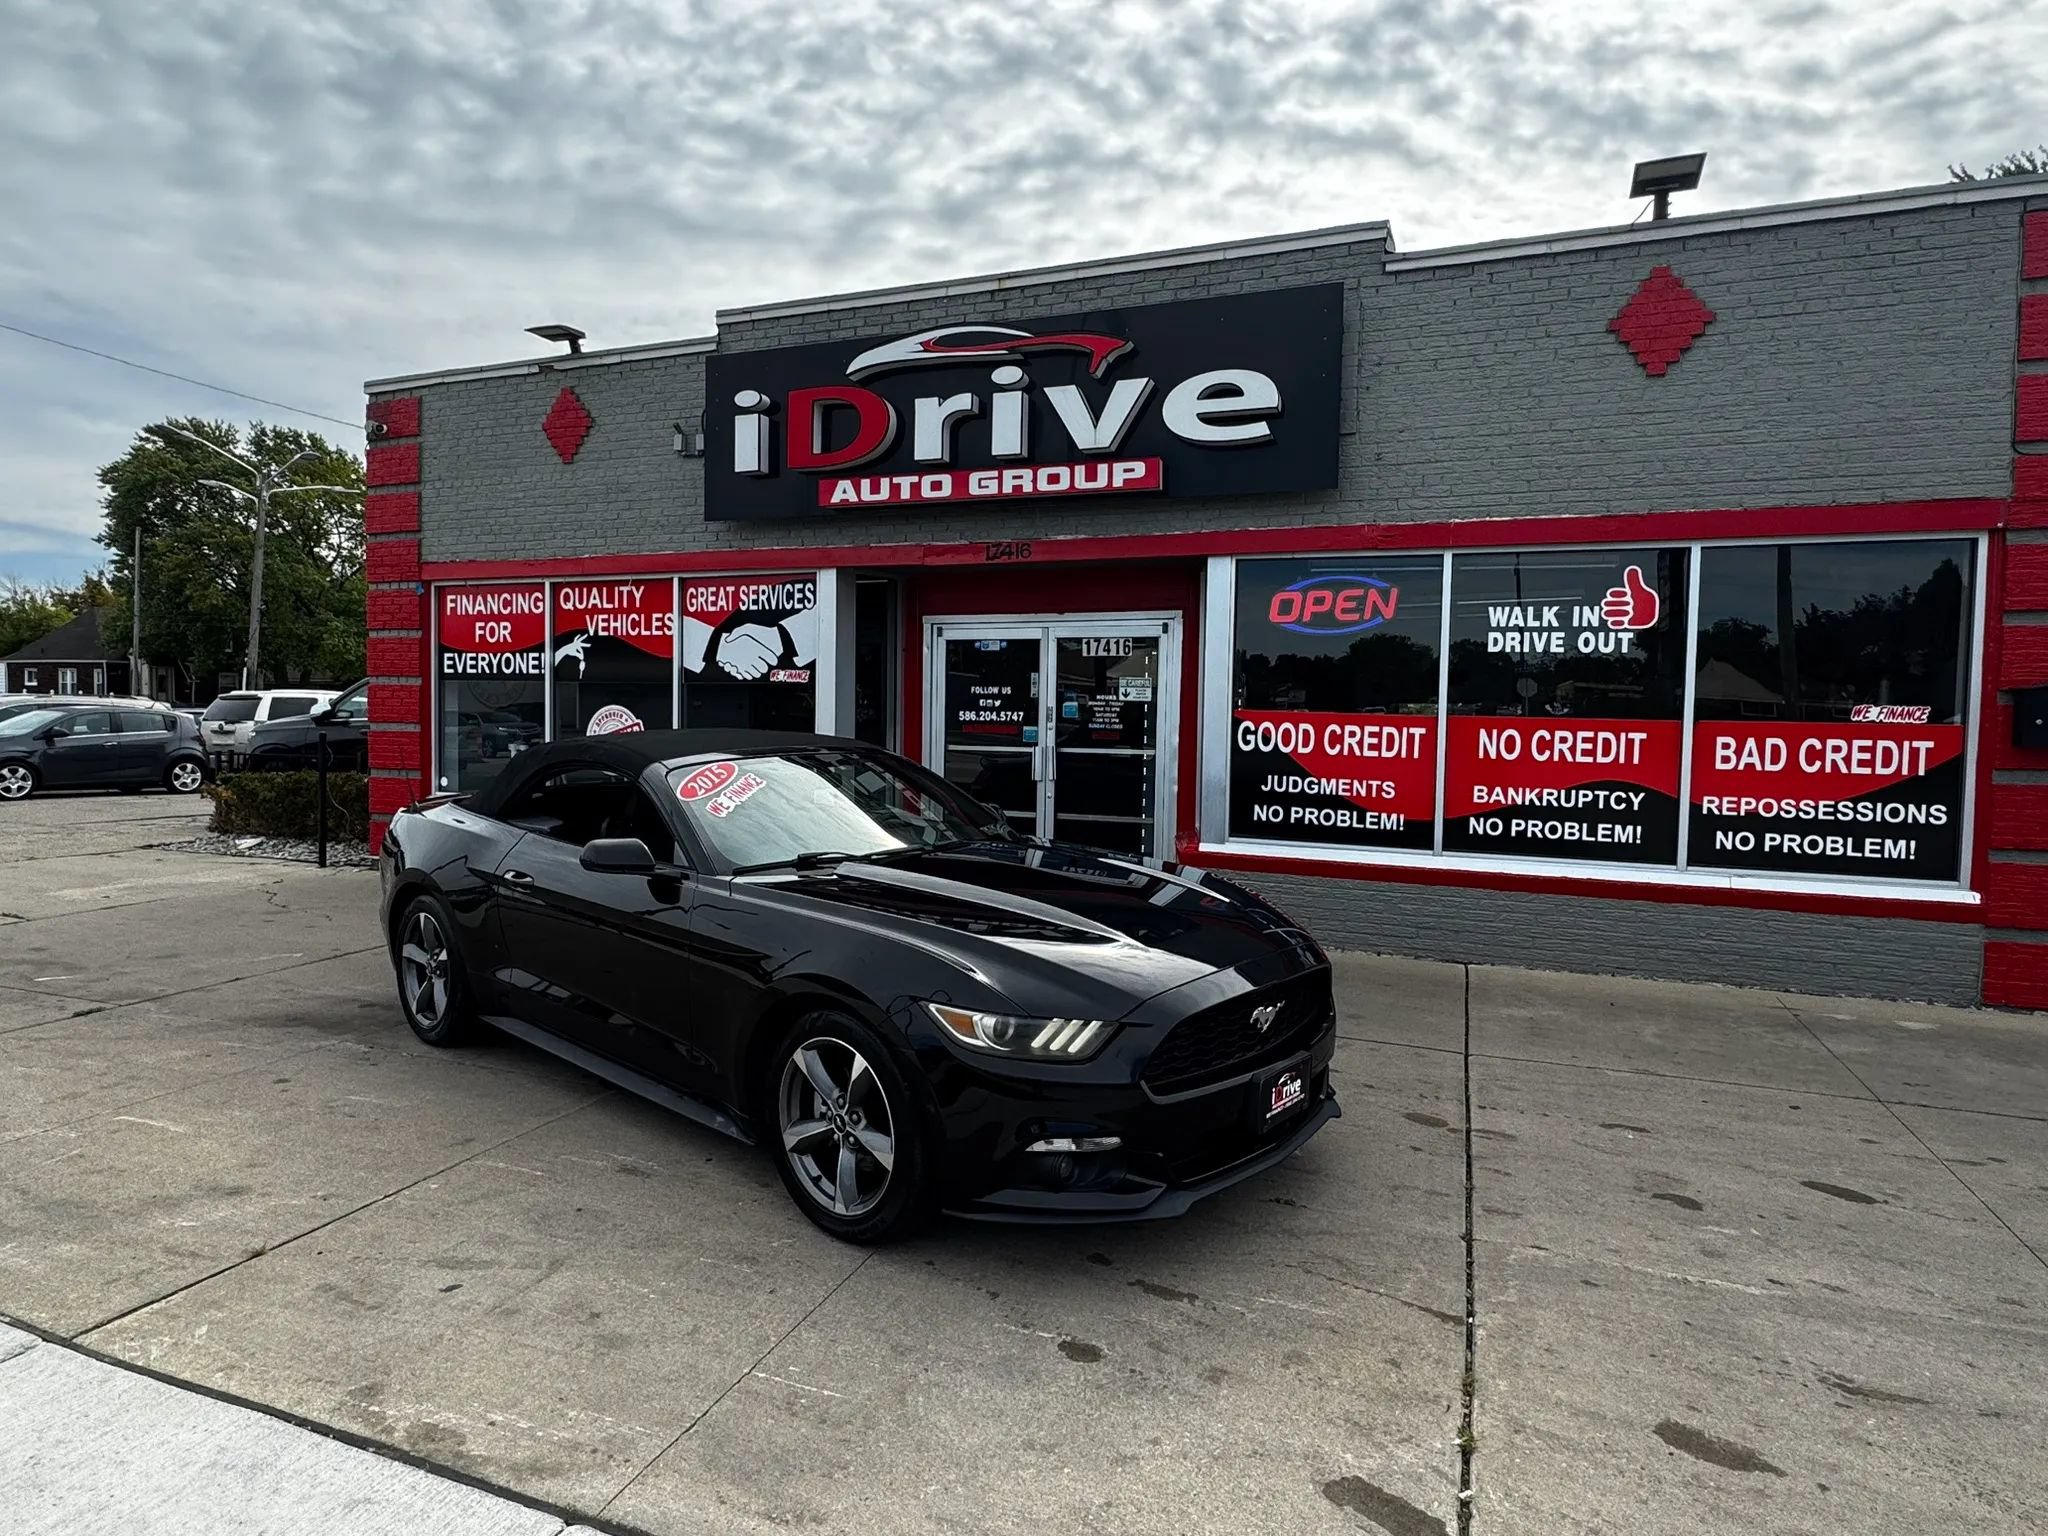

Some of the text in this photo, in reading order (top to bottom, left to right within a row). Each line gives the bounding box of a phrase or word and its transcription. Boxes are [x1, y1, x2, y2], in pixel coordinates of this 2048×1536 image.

[734, 366, 1282, 476] iDrive
[830, 461, 1146, 504] AUTO GROUP
[985, 542, 1032, 561] 17416
[446, 592, 545, 616] FINANCING
[560, 585, 645, 611] QUALITY
[686, 583, 815, 612] GREAT SERVICES
[1269, 586, 1398, 624] OPEN
[585, 612, 675, 637] VEHICLES
[1488, 605, 1601, 629] WALK IN
[475, 621, 513, 643] FOR
[1487, 631, 1635, 654] DRIVE OUT
[1084, 639, 1132, 656] 17416
[443, 652, 545, 675] EVERYONE!
[970, 686, 1012, 694] FOLLOW US
[959, 711, 1024, 721] 586.204.5747
[1852, 705, 1930, 721] WE FINANCE
[1237, 720, 1427, 760] GOOD CREDIT
[1478, 728, 1648, 765] NO CREDIT
[1715, 736, 1935, 776] BAD CREDIT
[688, 765, 728, 796] 2015
[1261, 774, 1396, 799] JUDGMENTS
[708, 774, 764, 816] WE FINANCE
[1473, 785, 1645, 811] BANKRUPTCY
[1253, 804, 1405, 831] NO PROBLEM!
[1702, 796, 1948, 826] REPOSSESSIONS
[1469, 817, 1643, 845] NO PROBLEM!
[1715, 831, 1917, 860] NO PROBLEM!
[1271, 1078, 1301, 1105] iDrive
